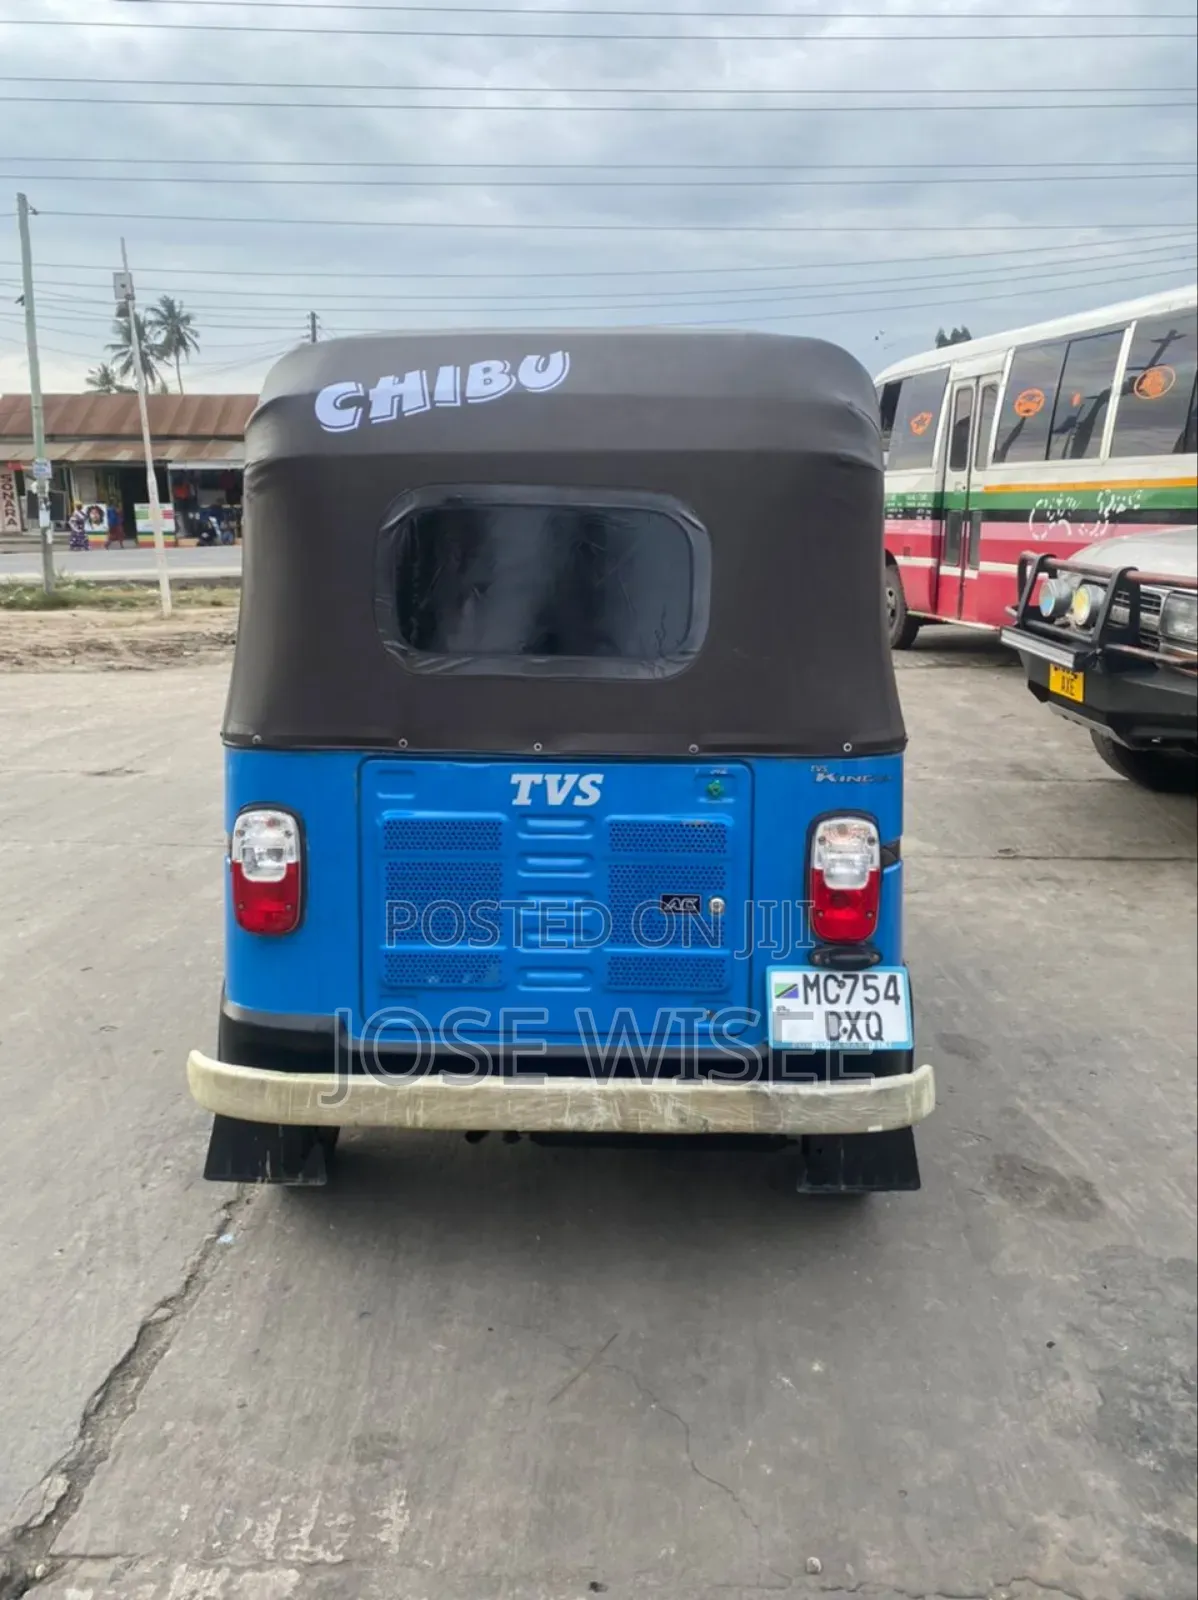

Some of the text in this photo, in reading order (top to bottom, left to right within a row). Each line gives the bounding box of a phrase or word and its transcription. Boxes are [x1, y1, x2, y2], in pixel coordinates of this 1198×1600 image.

[314, 350, 570, 433] CHIBU
[510, 773, 604, 806] TVS
[802, 974, 901, 1005] MC754
[825, 1011, 884, 1041] DXQ
